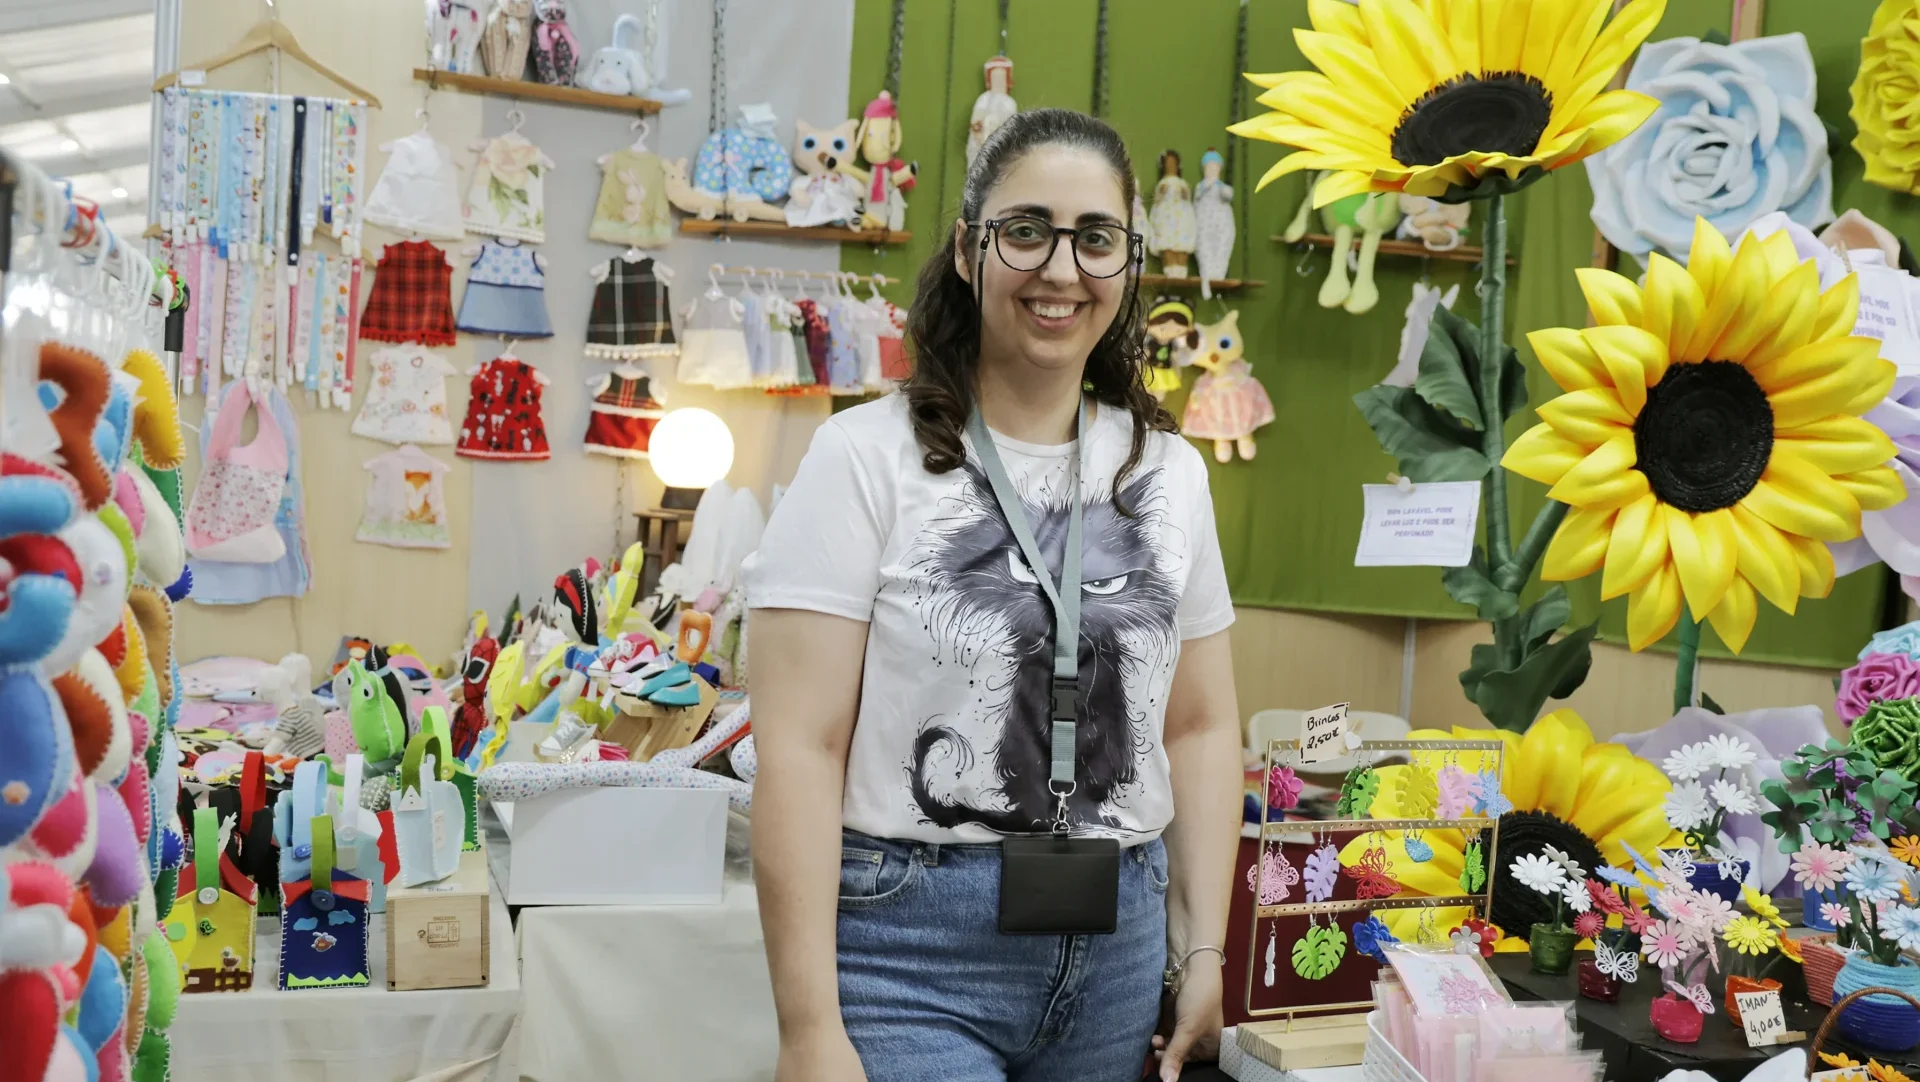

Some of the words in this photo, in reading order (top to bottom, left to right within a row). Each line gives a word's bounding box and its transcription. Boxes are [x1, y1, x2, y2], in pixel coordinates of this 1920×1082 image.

[1307, 713, 1340, 731] Brincos
[1307, 727, 1339, 749] 2,50€
[1738, 994, 1768, 1013] IMAN
[1749, 1015, 1781, 1039] 4,00€
